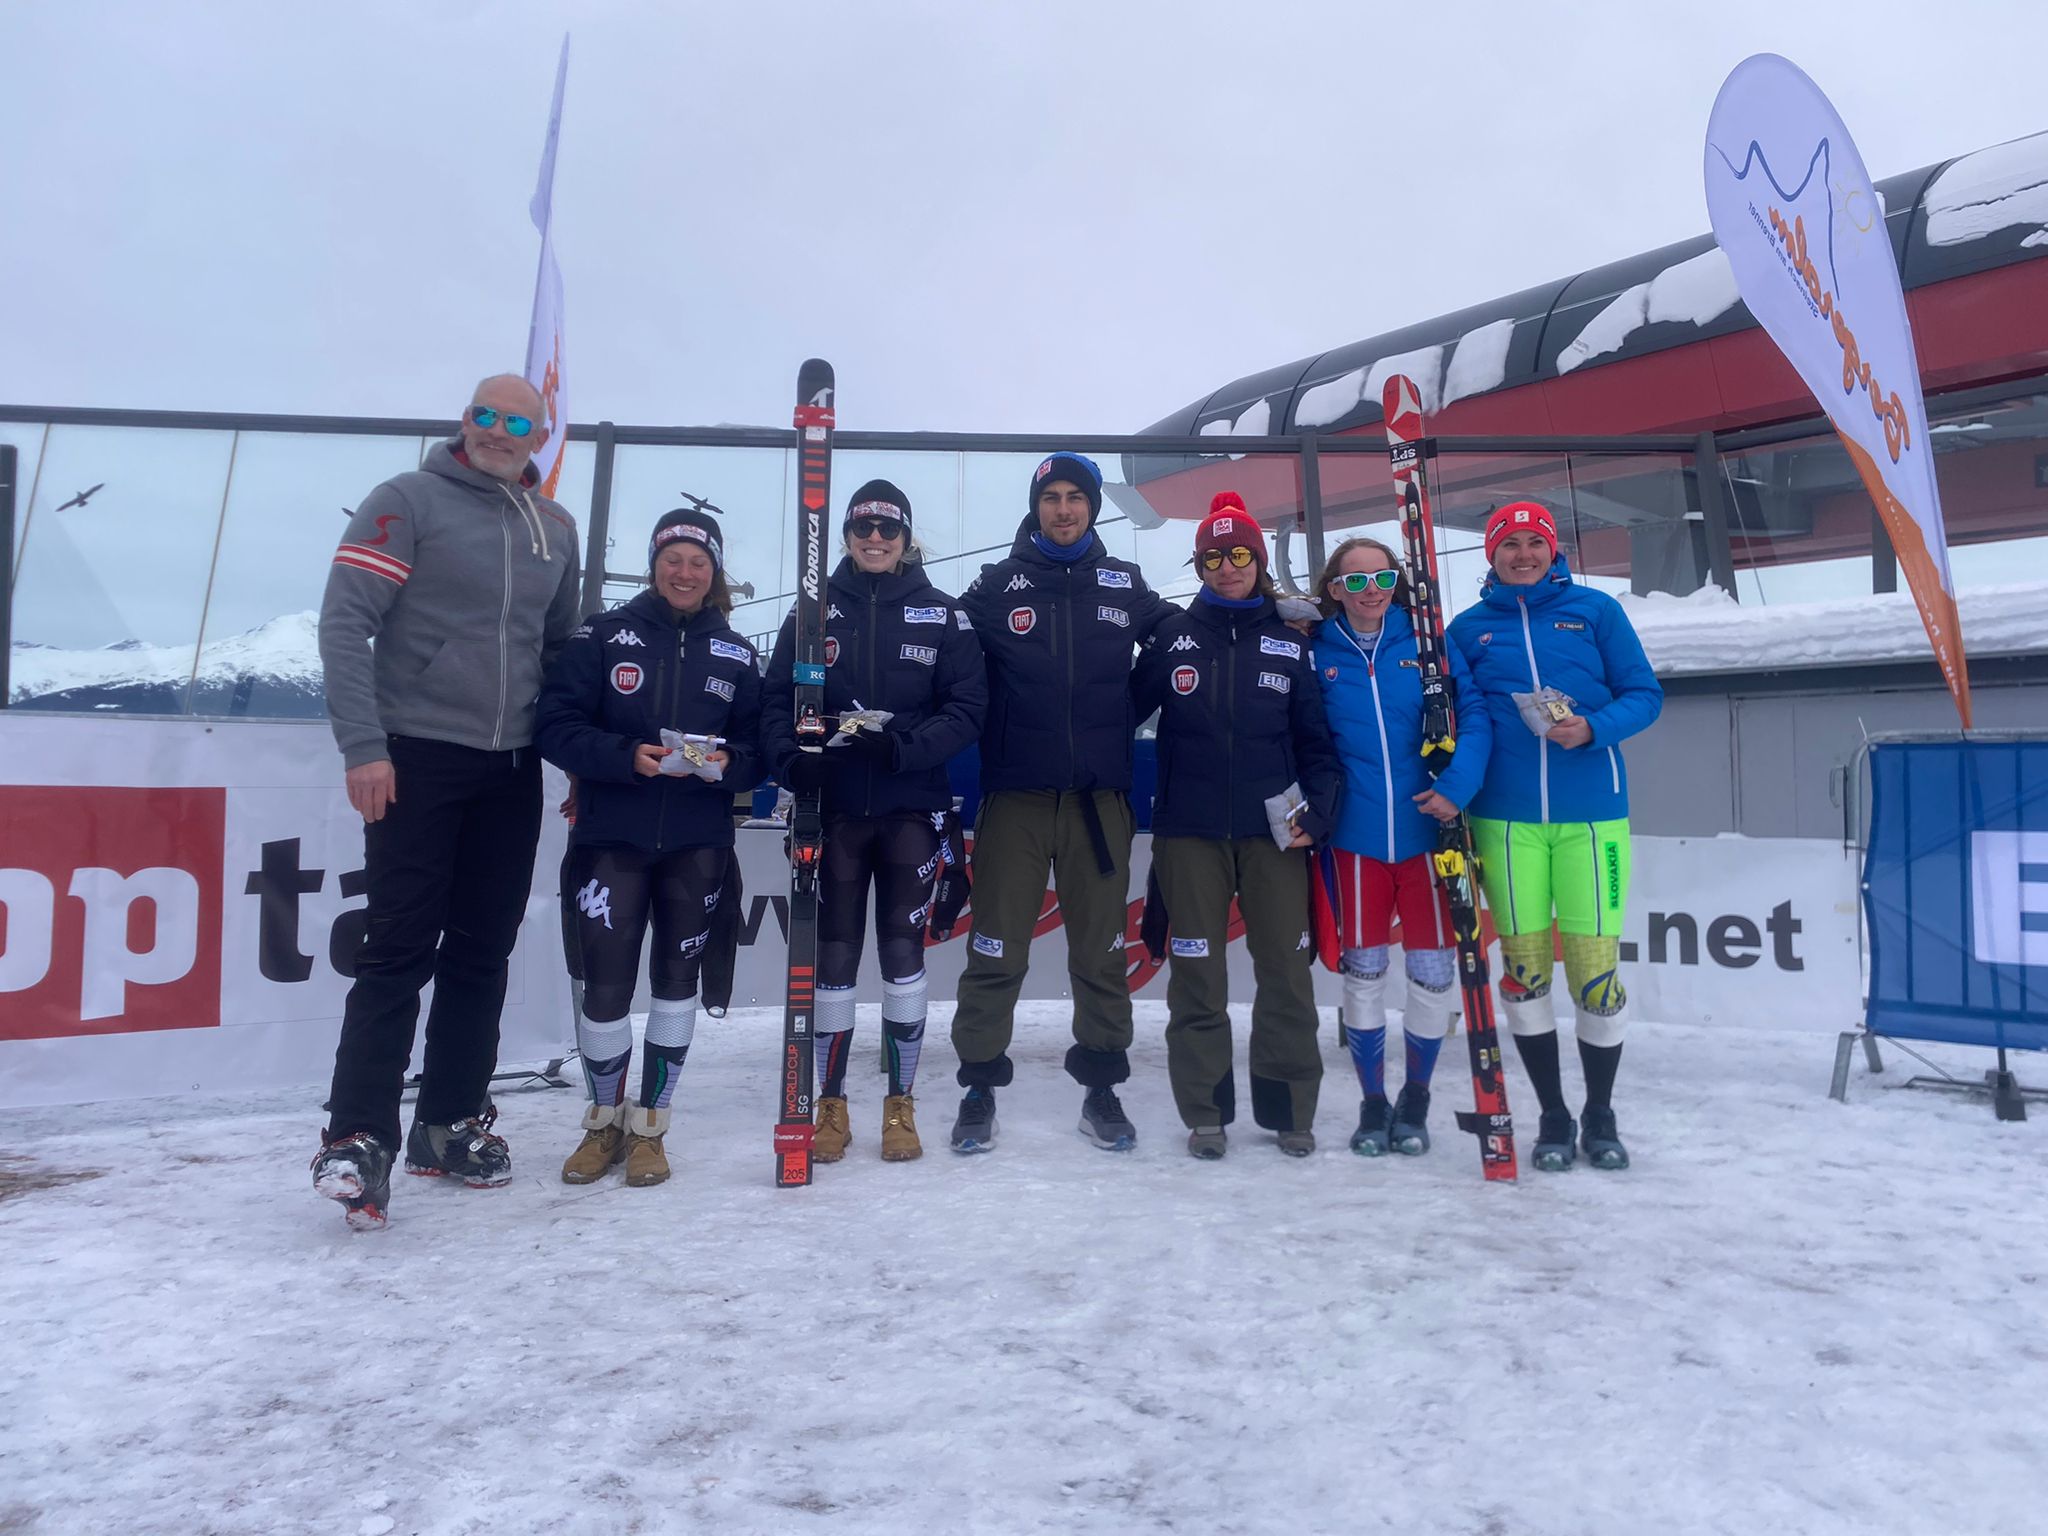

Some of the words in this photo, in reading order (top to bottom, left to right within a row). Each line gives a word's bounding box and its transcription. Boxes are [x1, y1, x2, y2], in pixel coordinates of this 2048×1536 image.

[802, 513, 819, 601] NORDICA
[906, 608, 937, 616] FISIP
[1015, 613, 1030, 628] FIAT
[619, 671, 637, 686] FIAT
[1177, 674, 1193, 688] FIAT
[1423, 683, 1442, 695] SP
[1555, 704, 1565, 714] 3
[1607, 846, 1619, 908] SLOVAKIA
[788, 1044, 799, 1070] CUP
[786, 1070, 798, 1115] WORLD
[798, 1094, 809, 1115] SG
[784, 1168, 806, 1181] 205
